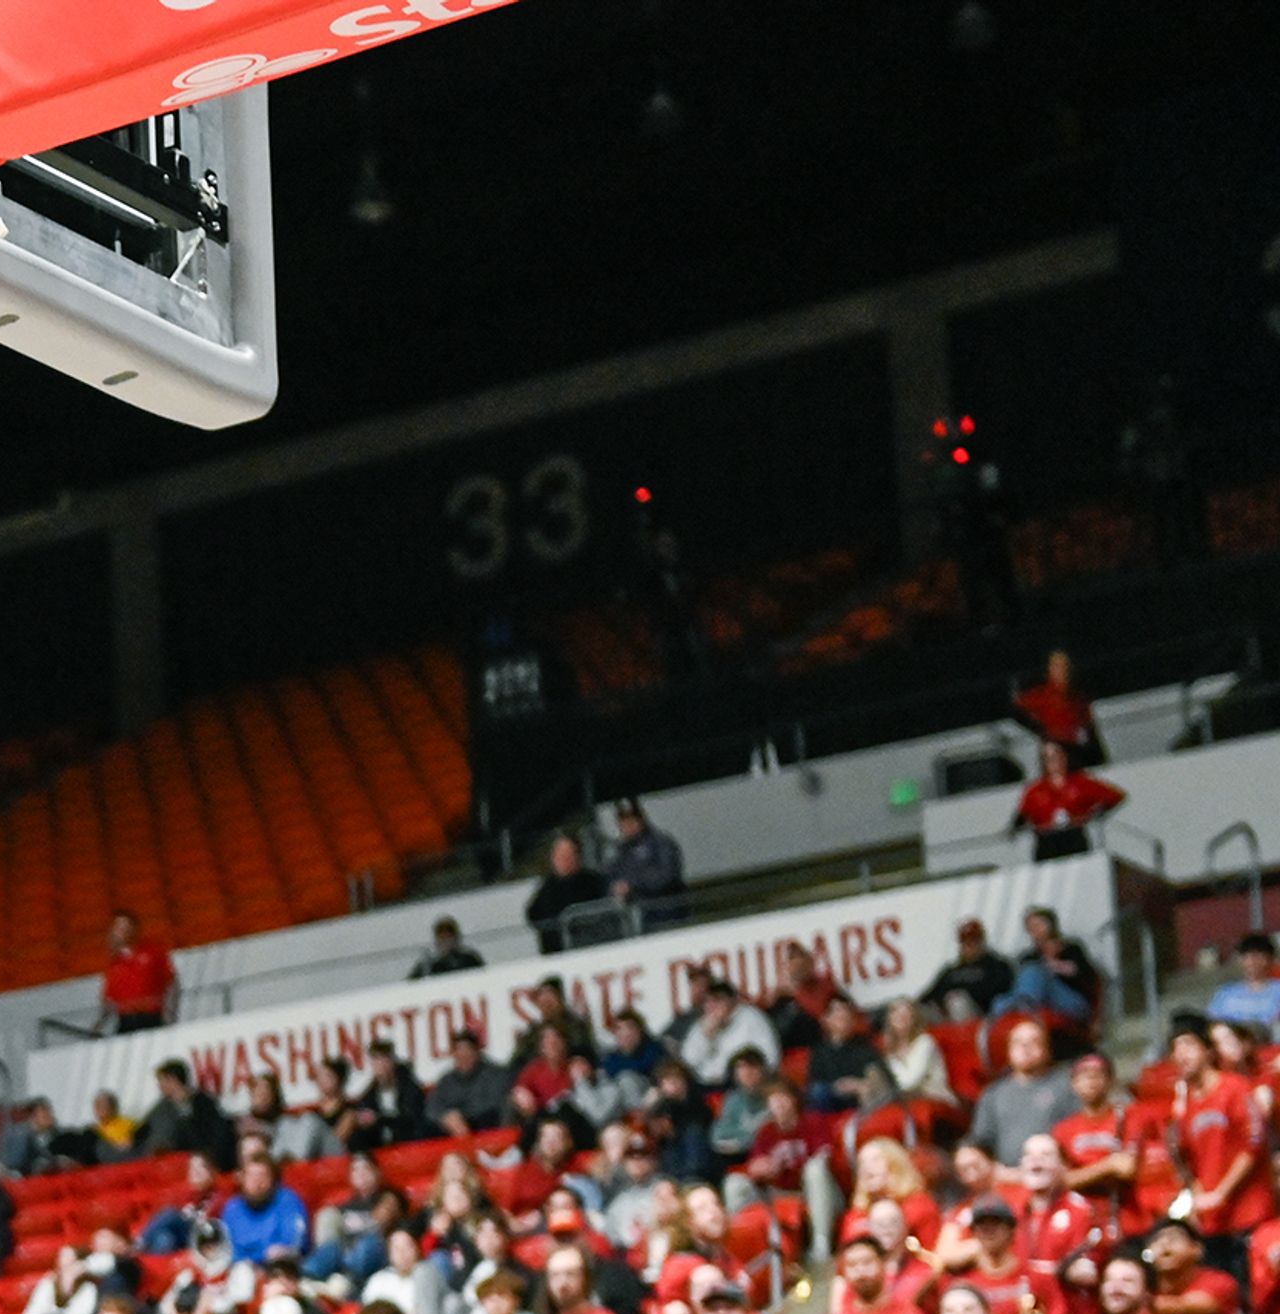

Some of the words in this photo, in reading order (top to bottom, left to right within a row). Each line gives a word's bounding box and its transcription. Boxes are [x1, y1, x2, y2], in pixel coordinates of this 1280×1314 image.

[441, 453, 588, 575] 33
[191, 995, 488, 1094] WASHINGTON
[510, 964, 644, 1034] SATE
